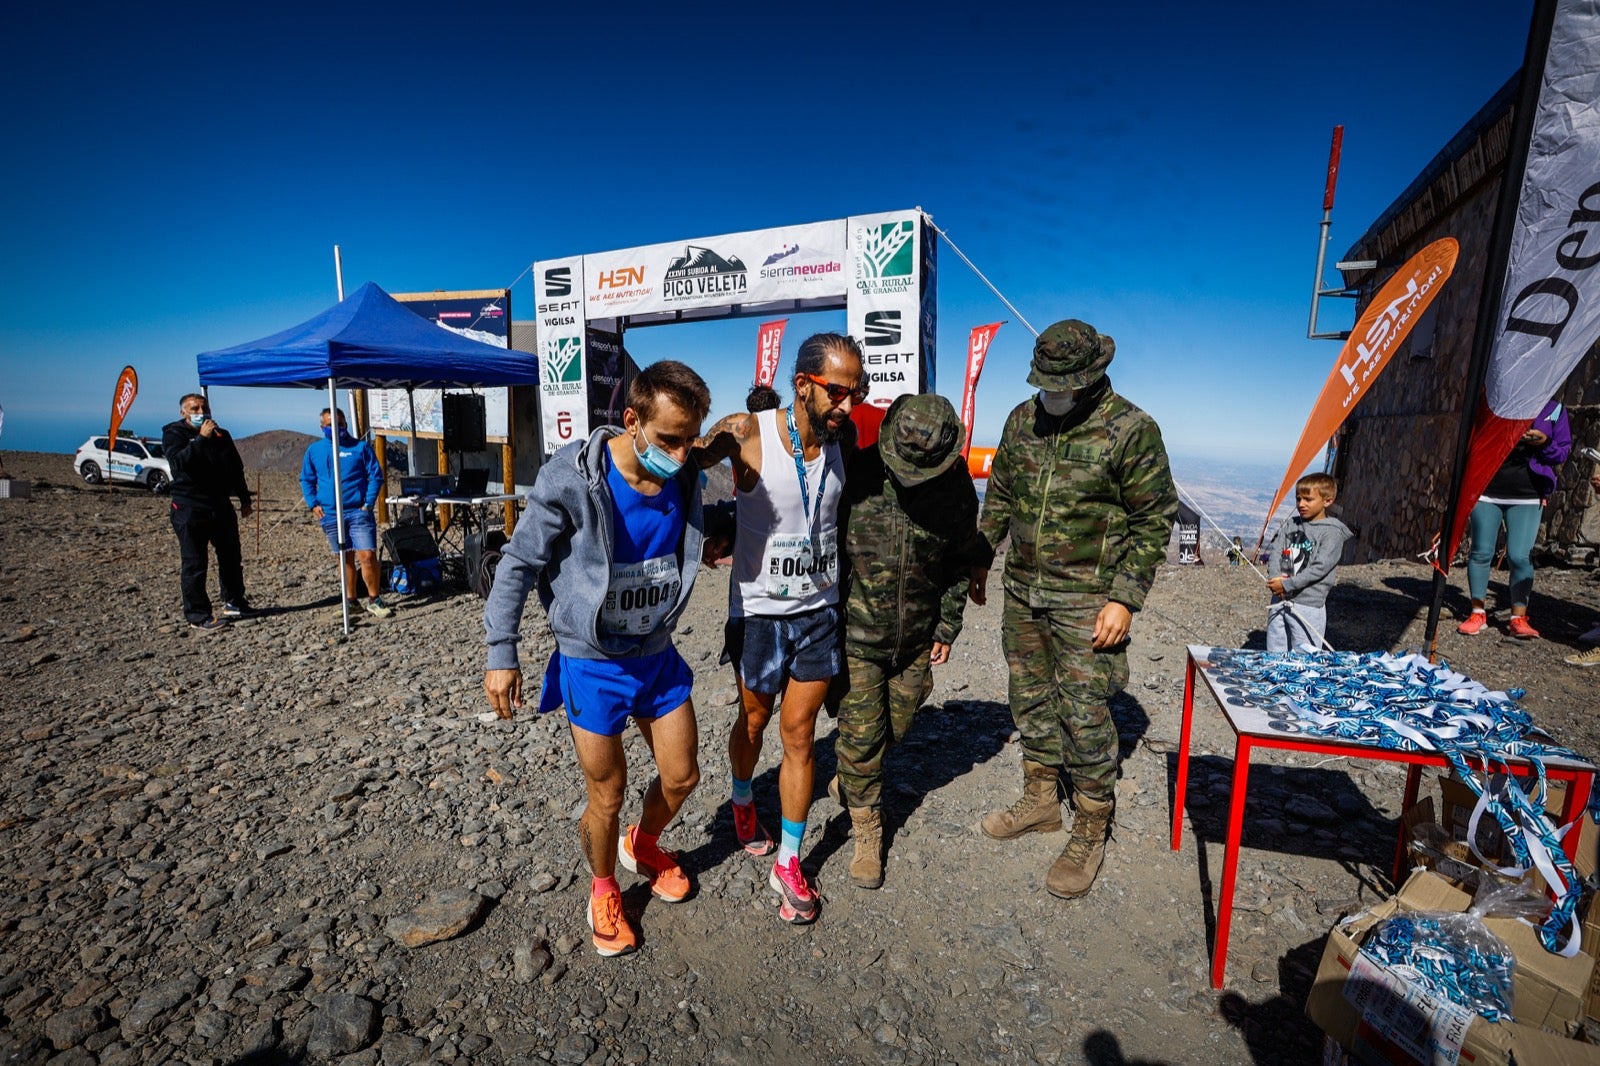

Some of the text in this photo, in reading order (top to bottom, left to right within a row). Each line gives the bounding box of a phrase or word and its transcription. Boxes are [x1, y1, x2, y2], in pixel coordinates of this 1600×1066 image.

[687, 265, 709, 276] SUBIDA
[710, 264, 718, 273] AL
[760, 261, 841, 279] sierranevada
[598, 265, 646, 289] HSN
[856, 277, 914, 289] CAJA RURAL
[663, 273, 748, 298] PICO VELETA
[873, 286, 908, 295] GRANADA
[602, 292, 615, 300] ARE
[538, 300, 580, 313] SEAT
[544, 317, 576, 327] VIGILSA
[1339, 277, 1418, 386] HSN
[1342, 265, 1443, 408] WE ARE NUTRITION!
[867, 371, 905, 382] IGILSA
[543, 384, 560, 392] CAJA
[613, 570, 635, 579] UBIDA
[620, 582, 669, 611] 0004
